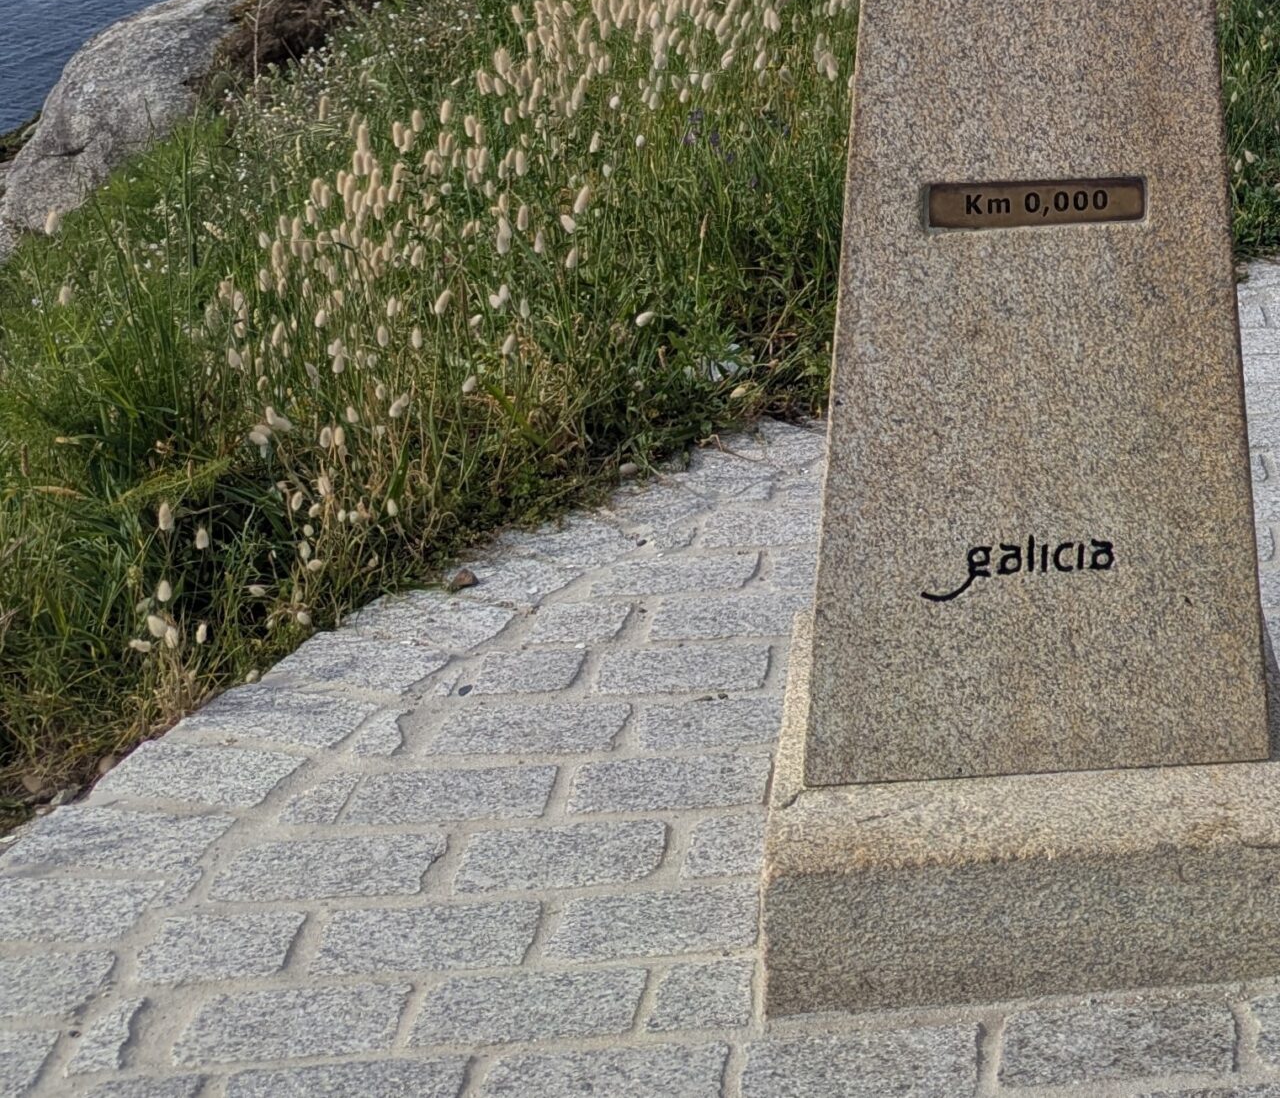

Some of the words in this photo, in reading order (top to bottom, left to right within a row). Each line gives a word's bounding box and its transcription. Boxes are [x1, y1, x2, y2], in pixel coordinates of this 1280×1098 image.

[965, 194, 1011, 215] Km
[1024, 189, 1109, 217] 0,000
[921, 535, 1115, 602] galicia
